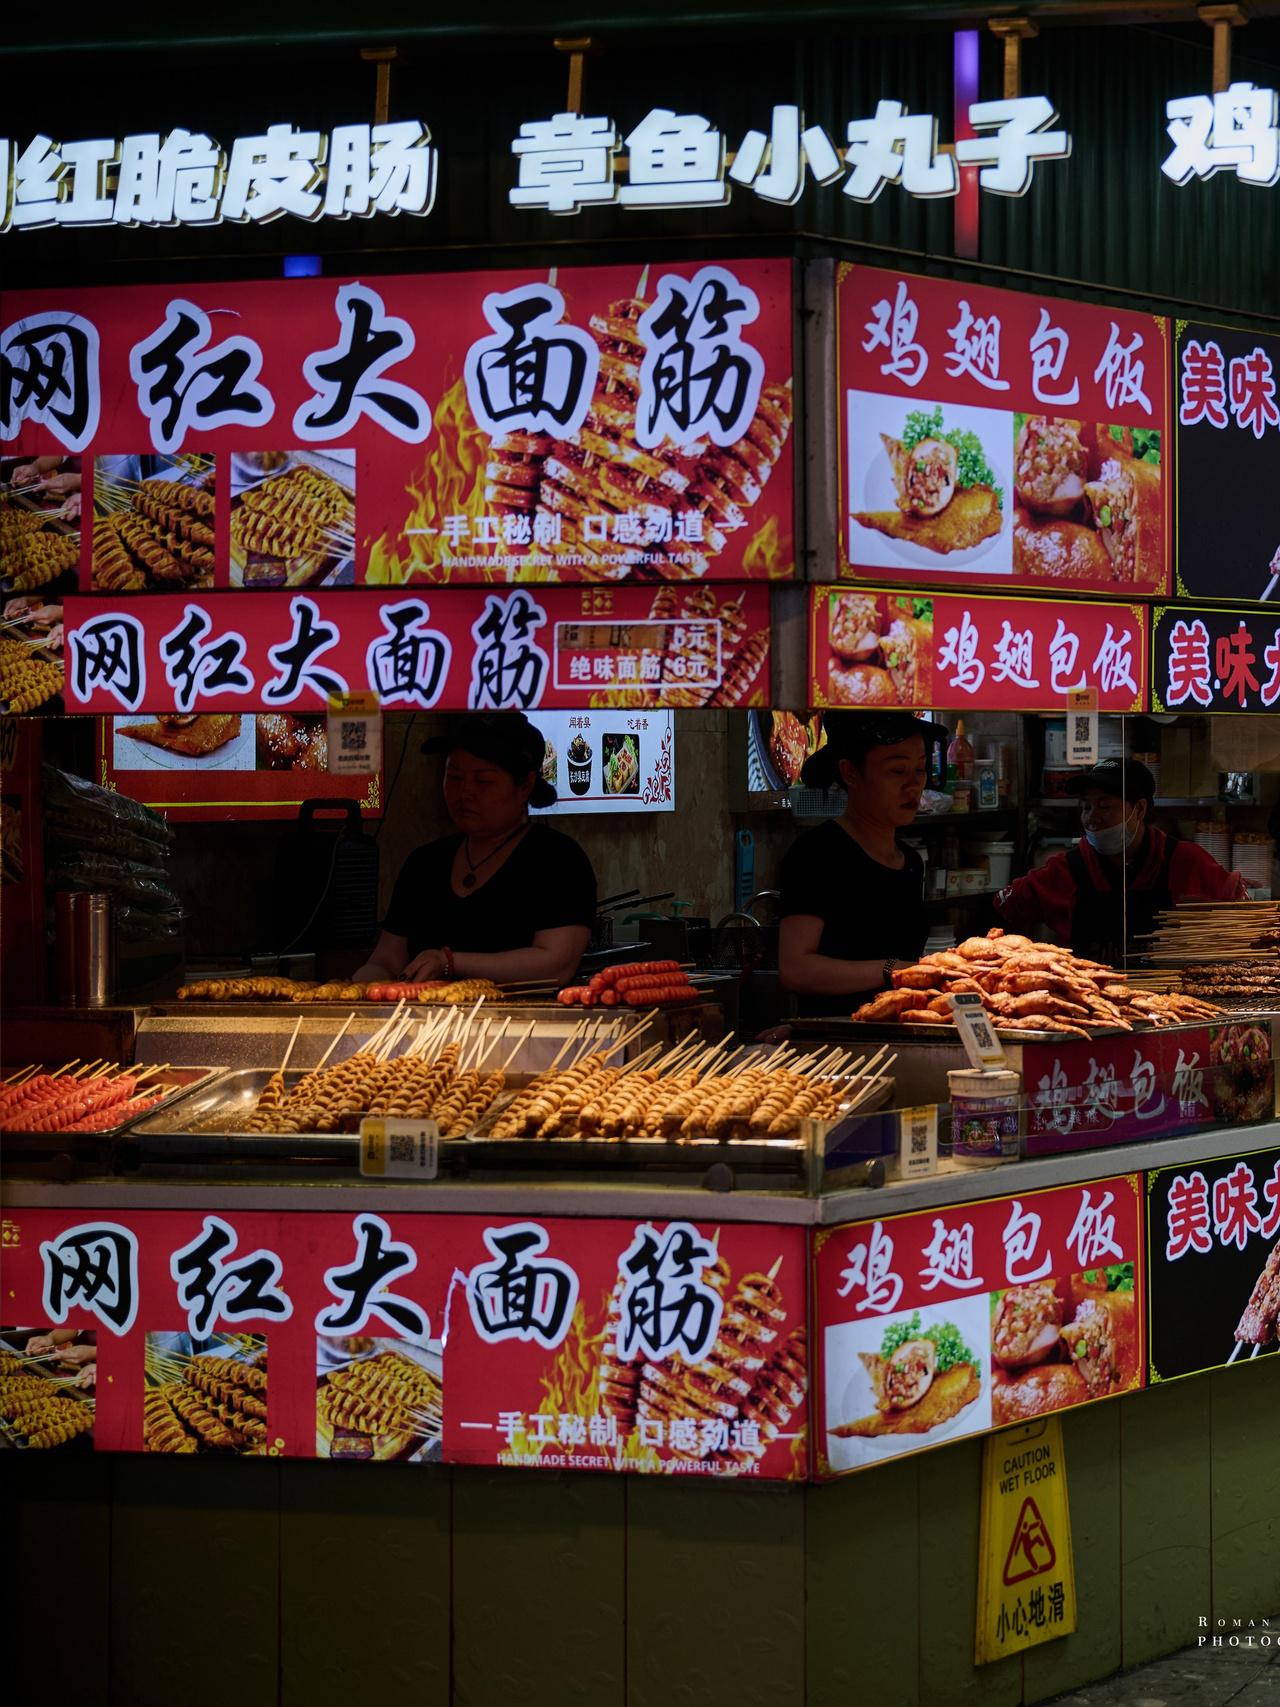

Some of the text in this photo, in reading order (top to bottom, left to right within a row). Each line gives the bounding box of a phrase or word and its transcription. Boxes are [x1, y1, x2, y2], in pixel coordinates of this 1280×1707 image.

[0, 120, 437, 232] 红脆皮肠
[509, 97, 1072, 214] 章鱼小丸子
[0, 267, 763, 453] 网红大面筋
[861, 280, 1153, 416] 鸡翅包饭
[441, 510, 706, 547] 手工秘制 口感劲道
[68, 589, 550, 712] 网红大面筋
[569, 655, 663, 681] 绝味面筋
[936, 610, 1139, 695] 鸡翅包饭
[627, 718, 649, 730] 吃着香
[1036, 1048, 1210, 1135] 鸡翅包饭
[40, 1213, 723, 1364] 网红大面筋
[837, 1190, 1124, 1314] 鸡翅包饭
[496, 1411, 761, 1452] 手工秘制 口感劲道
[496, 1453, 760, 1474] HANDMADE SECRET WITH A POWERFUL TASTE
[1003, 1445, 1051, 1474] CAUTION
[998, 1462, 1056, 1494] WET FLOOR
[996, 1581, 1065, 1644] 小心地滑
